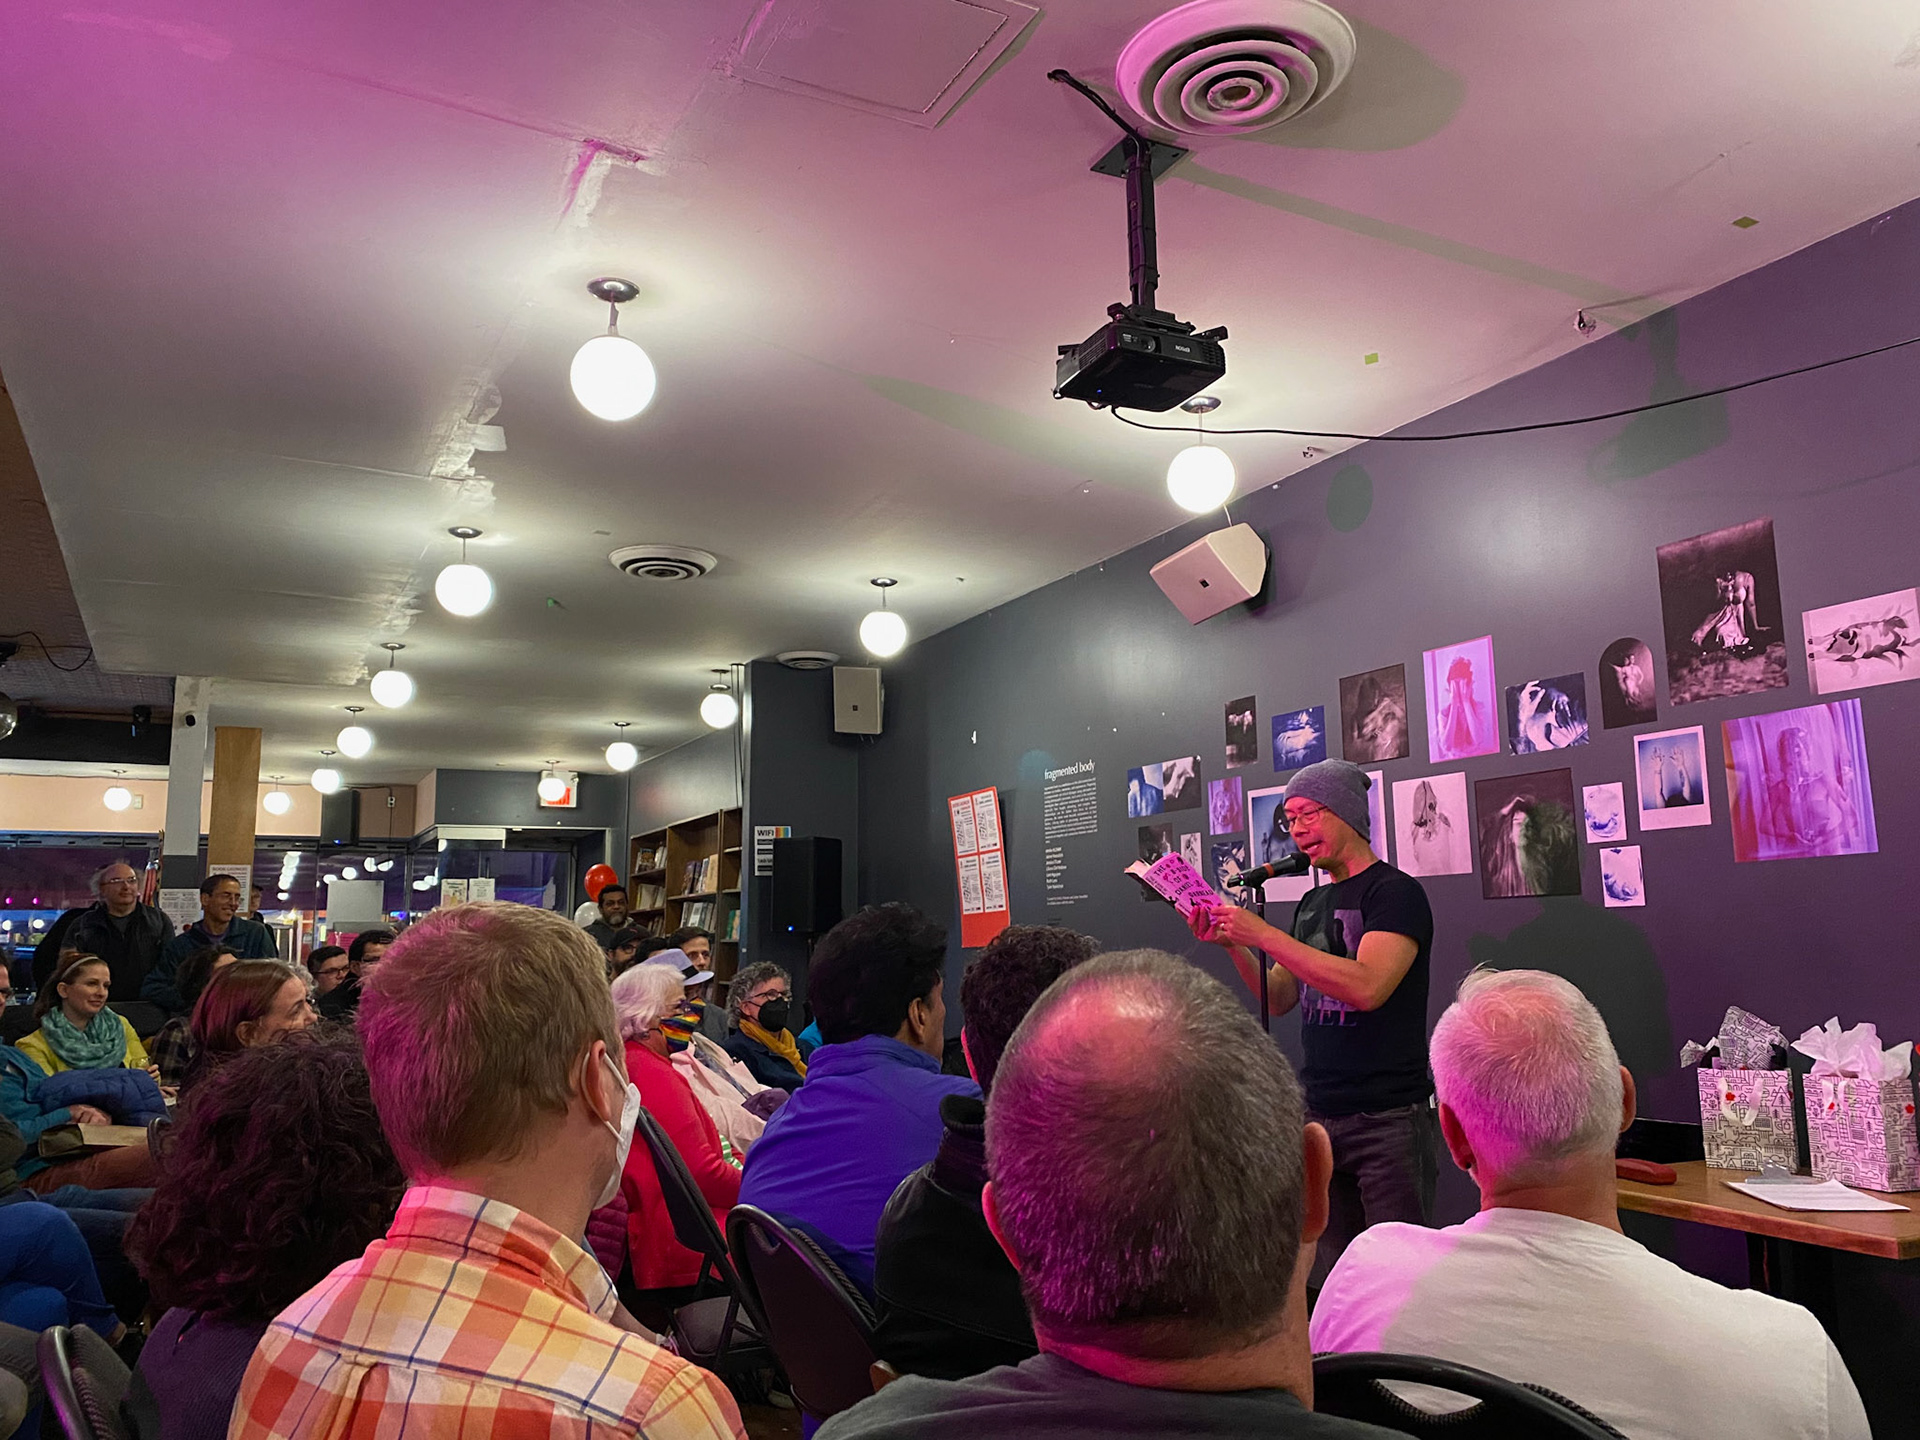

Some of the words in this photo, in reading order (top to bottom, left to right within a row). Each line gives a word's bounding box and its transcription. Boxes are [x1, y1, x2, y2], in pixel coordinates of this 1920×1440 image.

[1044, 761, 1078, 782] fragmented
[1079, 758, 1095, 774] body
[1153, 864, 1167, 877] THE
[1173, 876, 1182, 884] OF
[1174, 881, 1194, 896] DANIEL
